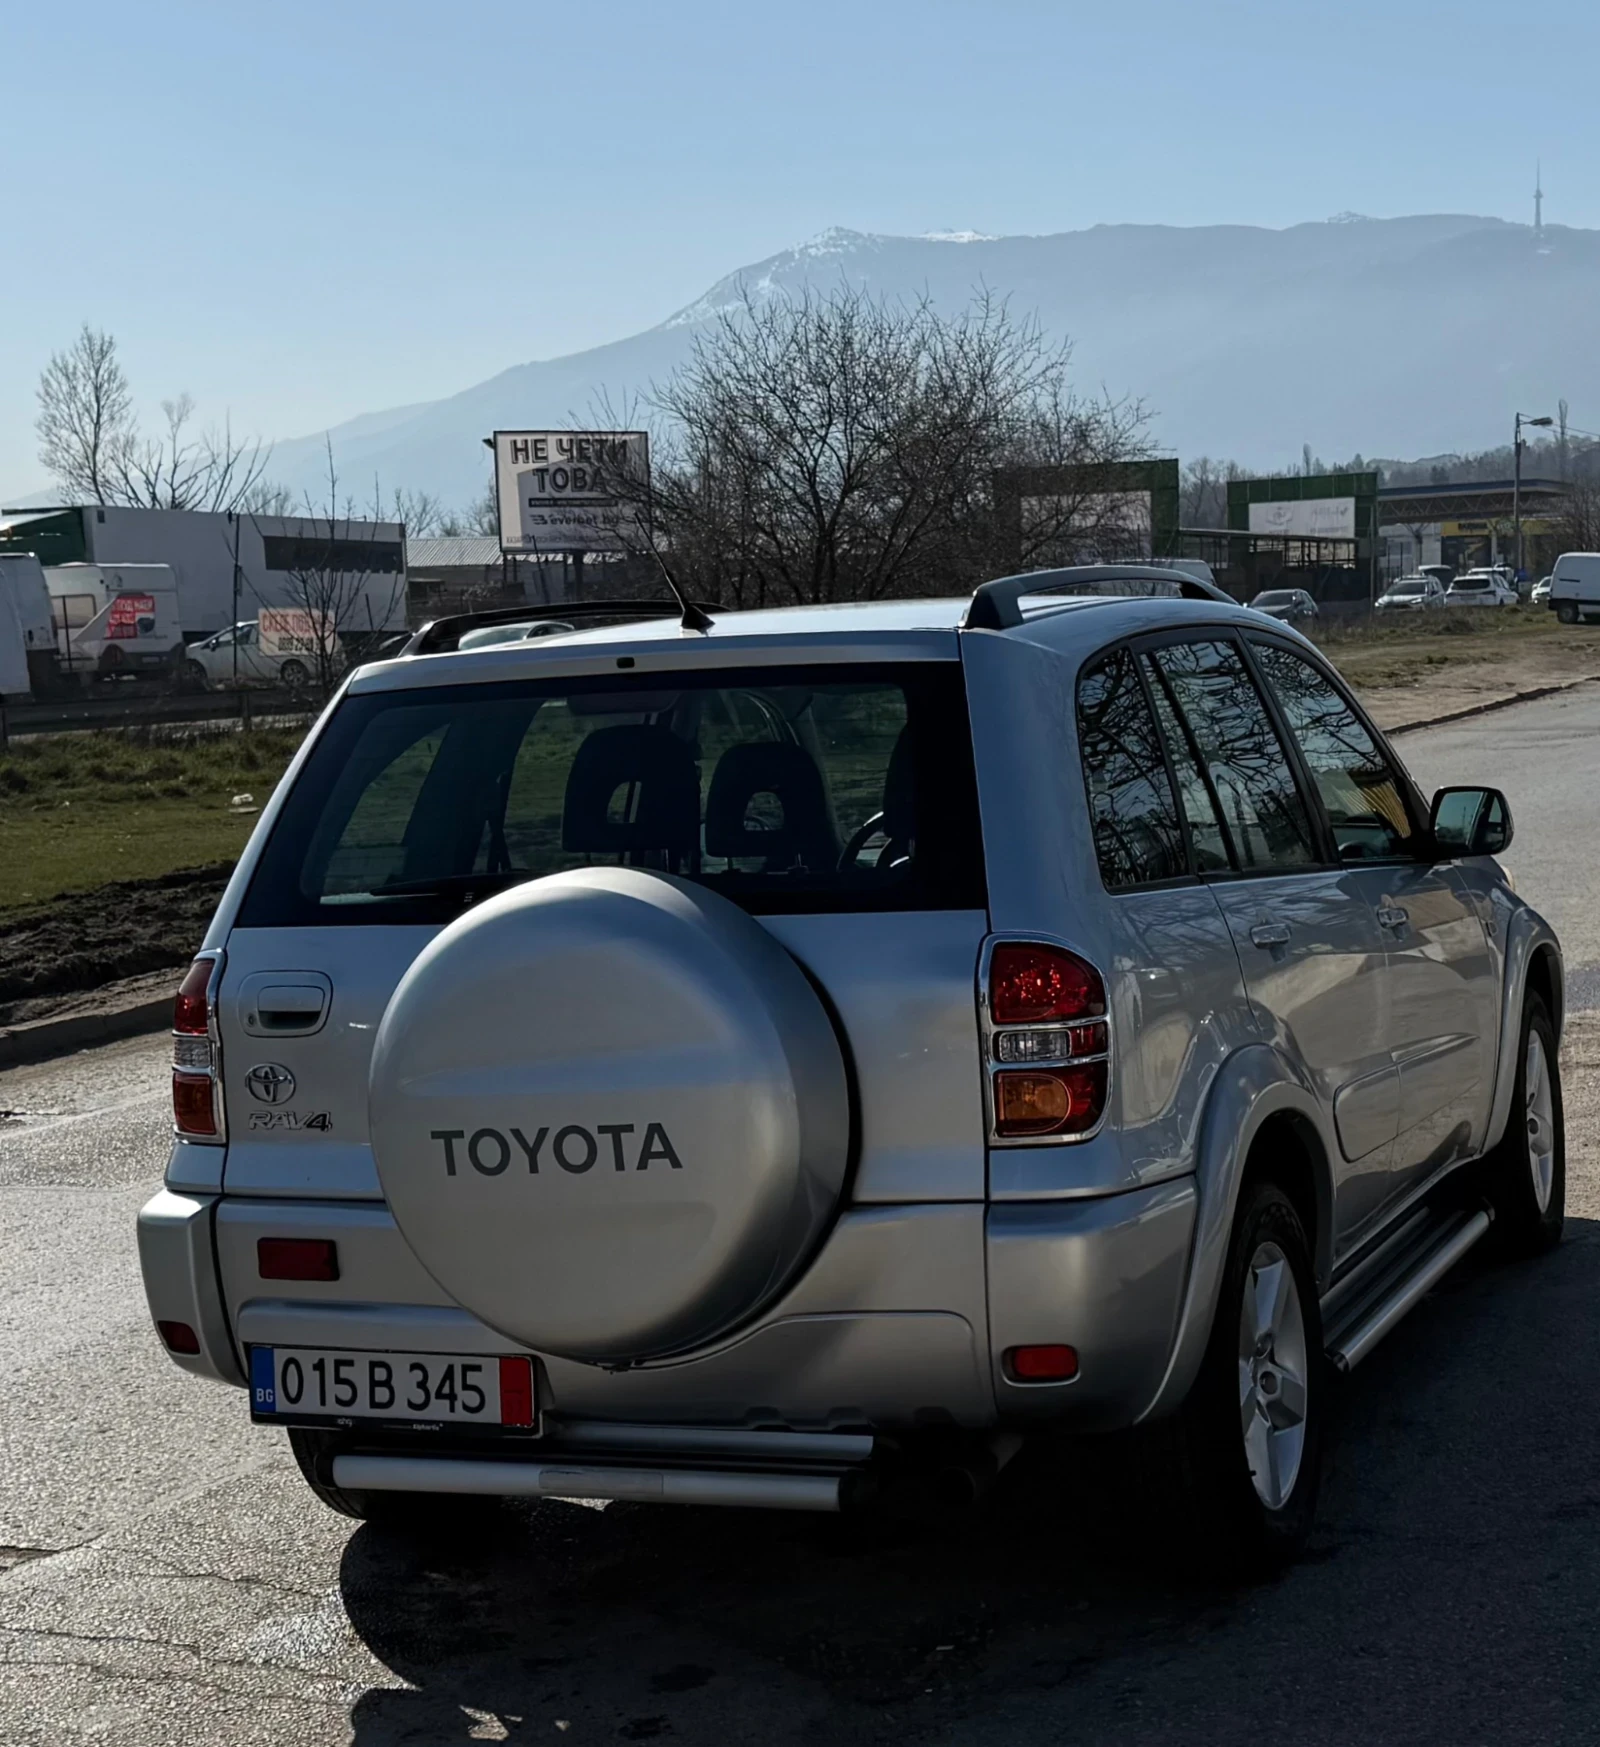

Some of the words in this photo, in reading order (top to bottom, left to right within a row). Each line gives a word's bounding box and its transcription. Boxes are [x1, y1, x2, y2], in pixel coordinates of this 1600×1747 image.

[510, 438, 549, 464] НЕ
[533, 467, 608, 493] ТОВА
[248, 1110, 333, 1132] RAV4
[431, 1123, 683, 1177] TOYOTA
[255, 1388, 274, 1402] BG
[281, 1356, 358, 1408] 015
[406, 1362, 486, 1414] 345
